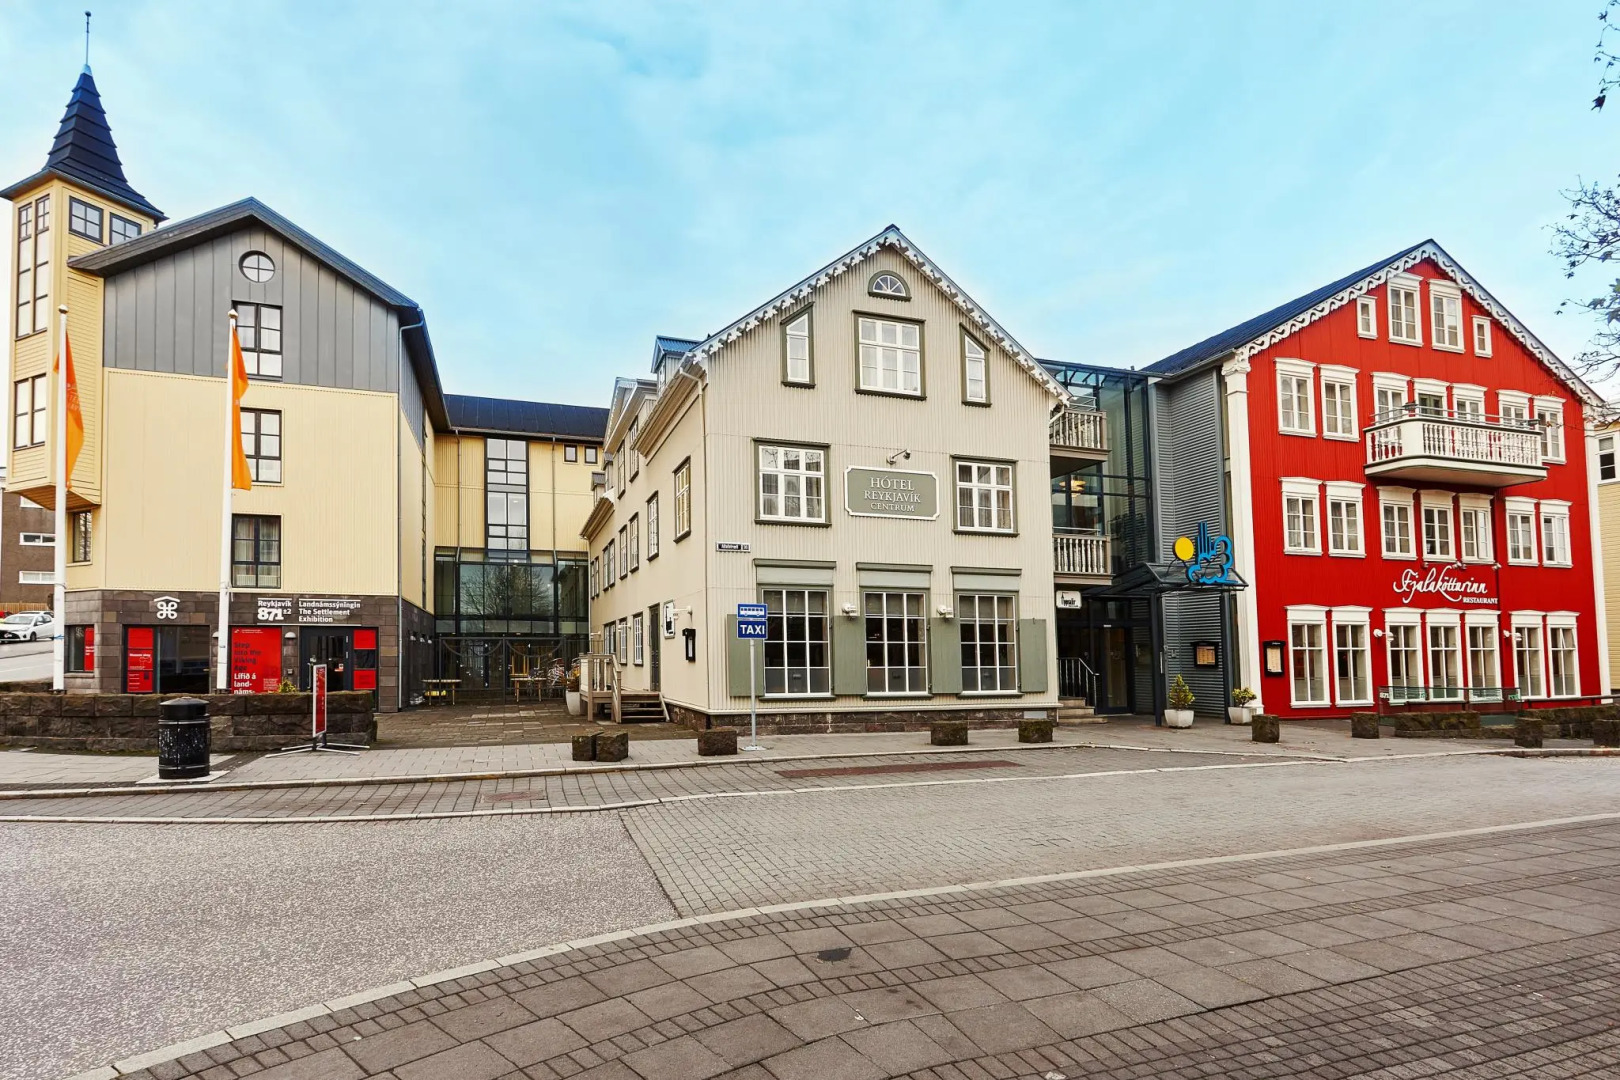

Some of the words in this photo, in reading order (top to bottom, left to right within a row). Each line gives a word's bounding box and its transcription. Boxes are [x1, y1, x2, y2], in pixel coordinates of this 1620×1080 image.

[870, 475, 915, 490] HÓTEL
[864, 490, 921, 503] REYKJAVÍK
[870, 503, 915, 512] CENTRUM
[257, 600, 292, 608] Reykjavík
[1462, 596, 1498, 604] RESTAURANT
[298, 601, 361, 610] Landnámssýningin
[313, 608, 350, 616] Settlement
[298, 615, 334, 623] Exhibition
[740, 624, 765, 635] TAXI
[233, 680, 252, 688] land-
